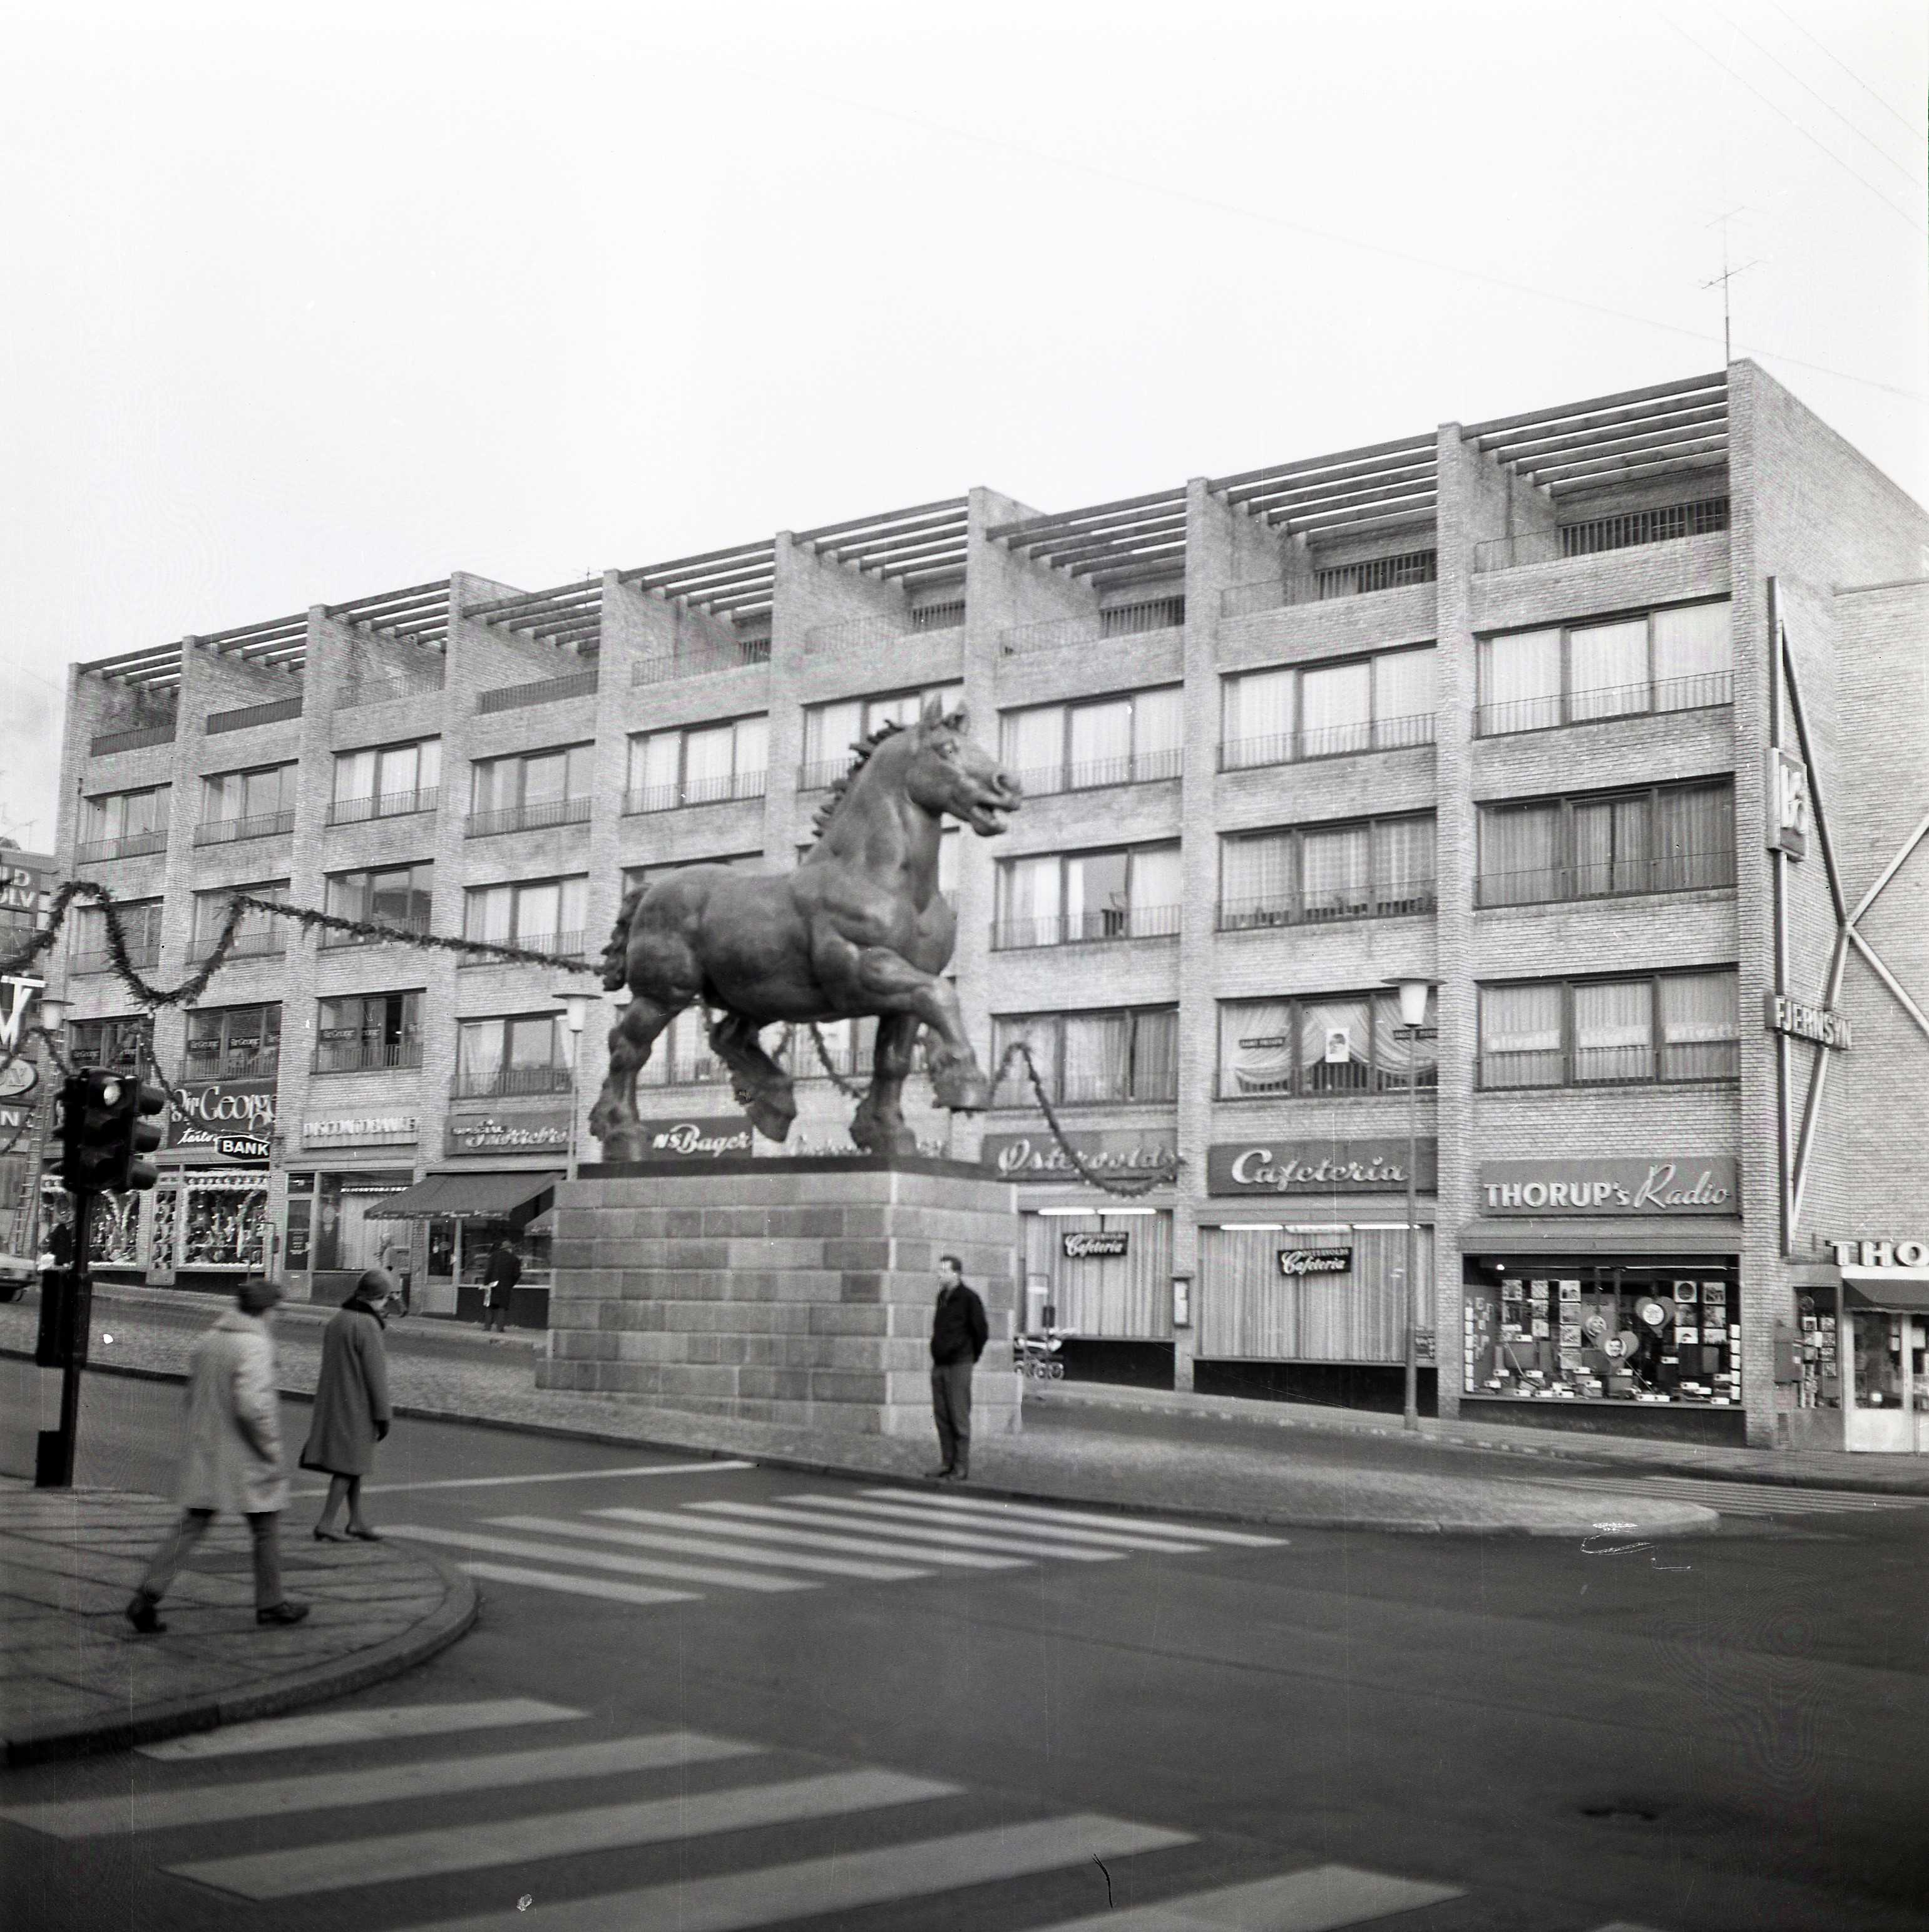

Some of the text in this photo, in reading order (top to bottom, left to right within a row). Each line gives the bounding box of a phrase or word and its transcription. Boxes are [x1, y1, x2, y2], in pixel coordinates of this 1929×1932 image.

[1775, 998, 1852, 1049] FJERNSYN
[223, 1140, 270, 1156] BANK
[1231, 1148, 1408, 1191] Cafeteria
[1484, 1163, 1732, 1210] THORUP's Radio
[1065, 1234, 1123, 1258] Cafeteria
[1826, 1240, 1929, 1267] THO
[1281, 1251, 1346, 1275] Cafeteria
